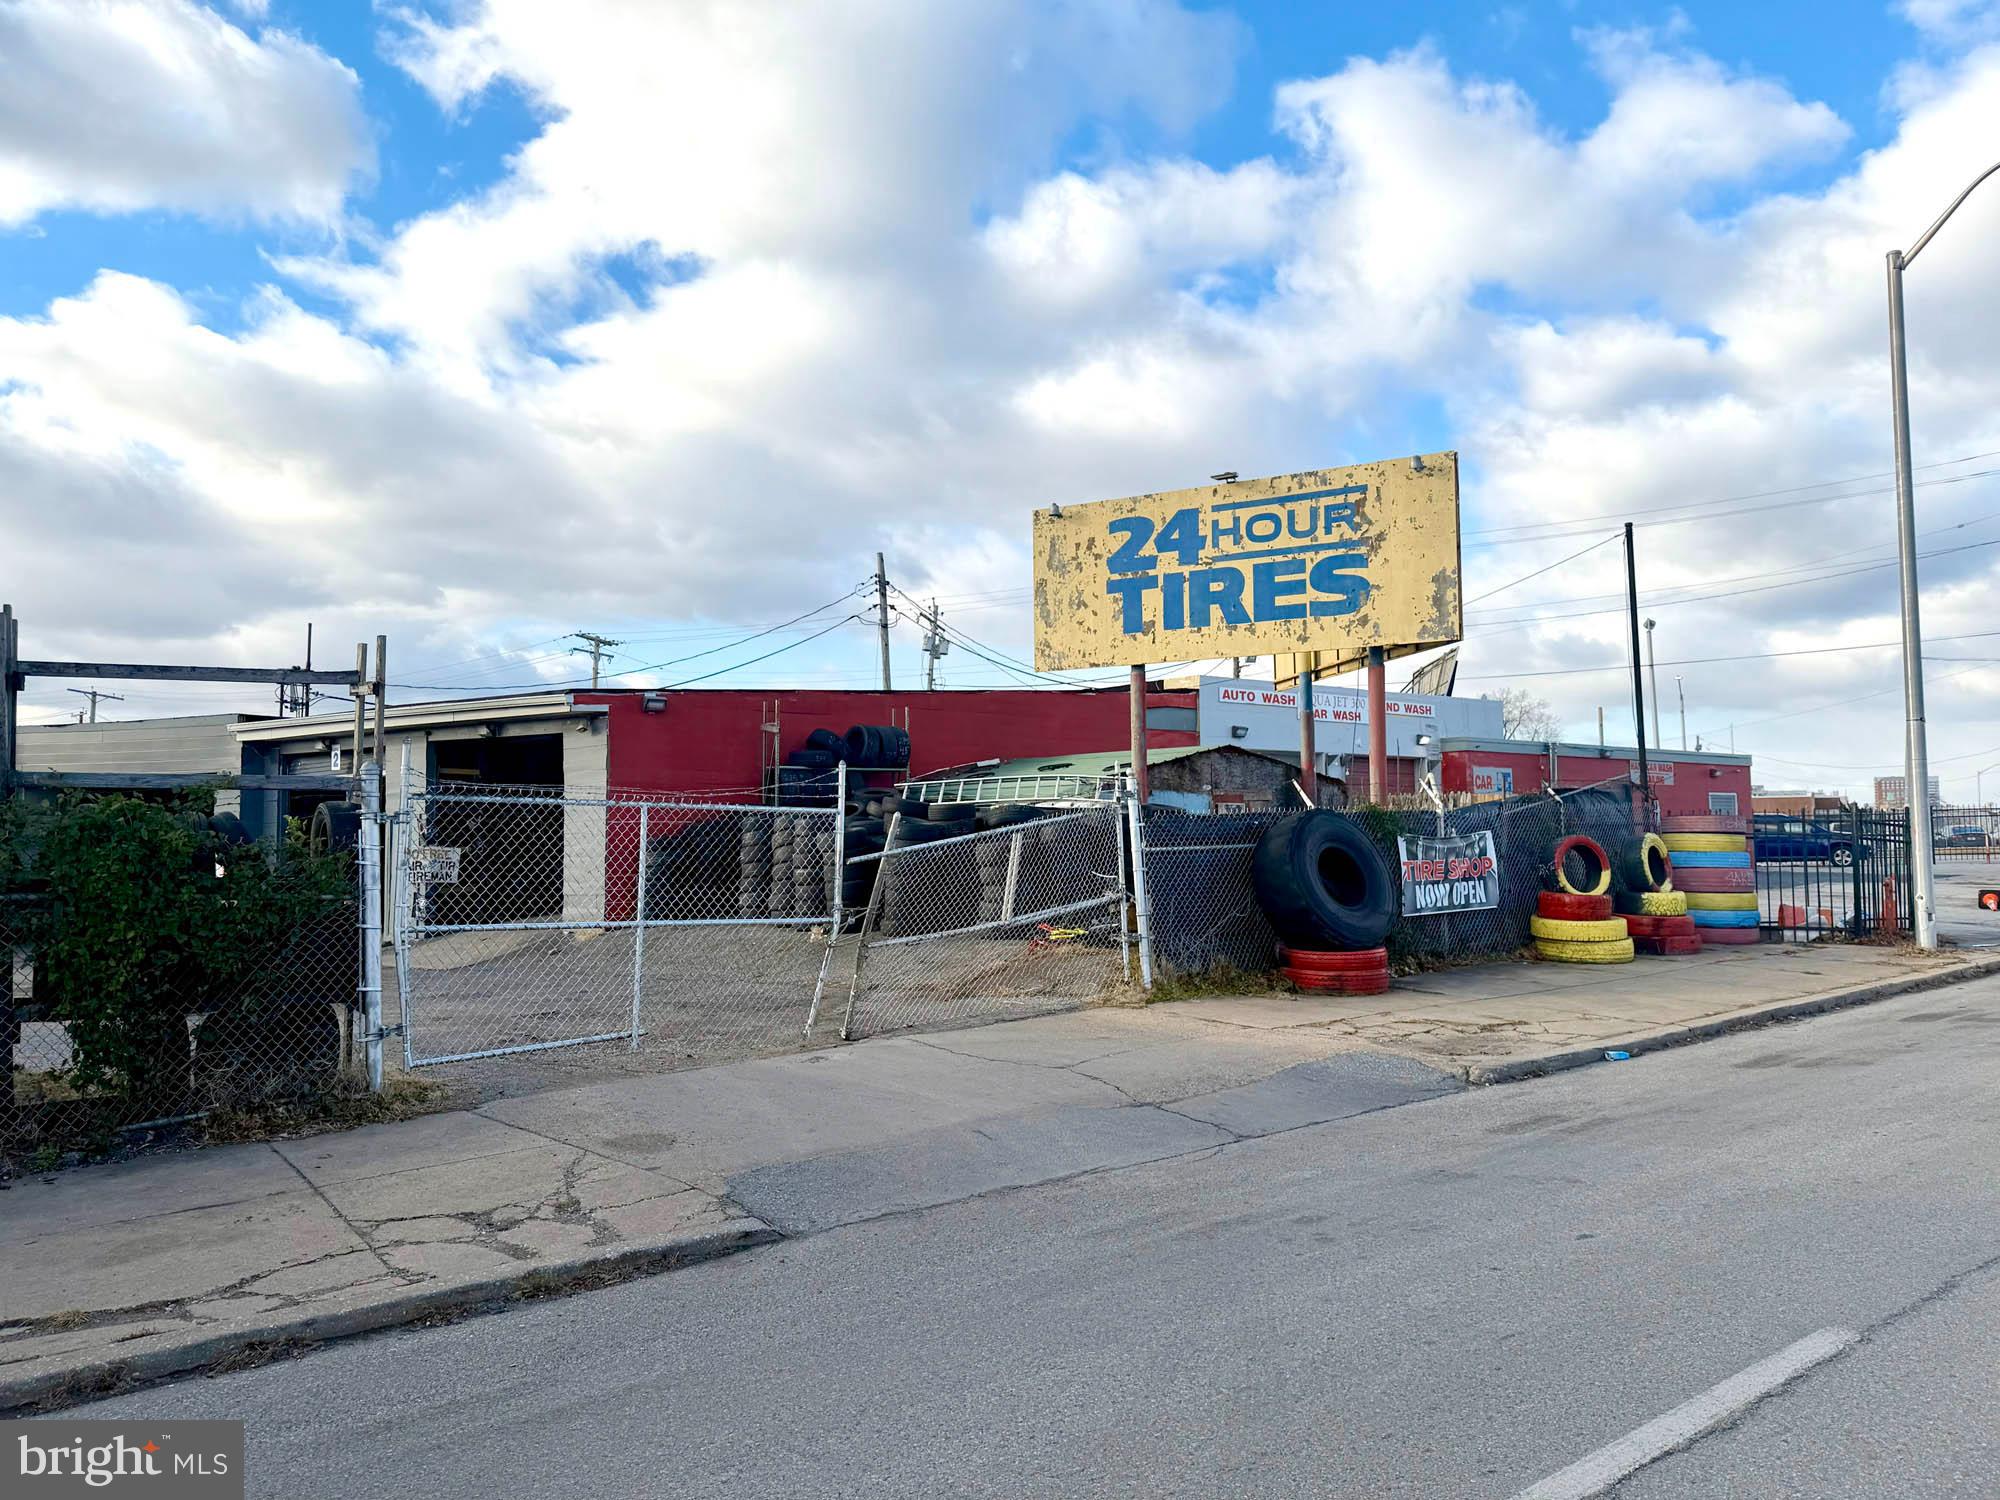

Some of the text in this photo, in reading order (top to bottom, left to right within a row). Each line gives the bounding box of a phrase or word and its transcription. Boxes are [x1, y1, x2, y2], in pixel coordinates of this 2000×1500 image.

[1106, 501, 1368, 574] 24 HOUR
[1106, 553, 1371, 634] TIRES
[1222, 689, 1296, 706] AUTO WASH
[1311, 694, 1331, 707] QUA
[1333, 696, 1348, 708] JET
[1313, 709, 1361, 721] AR WASH
[1386, 702, 1432, 715] ND WASH
[333, 752, 339, 767] 2
[1475, 774, 1493, 790] CAR
[1402, 856, 1493, 881] TIRE SHOP
[1416, 880, 1487, 909] NOW OPEN
